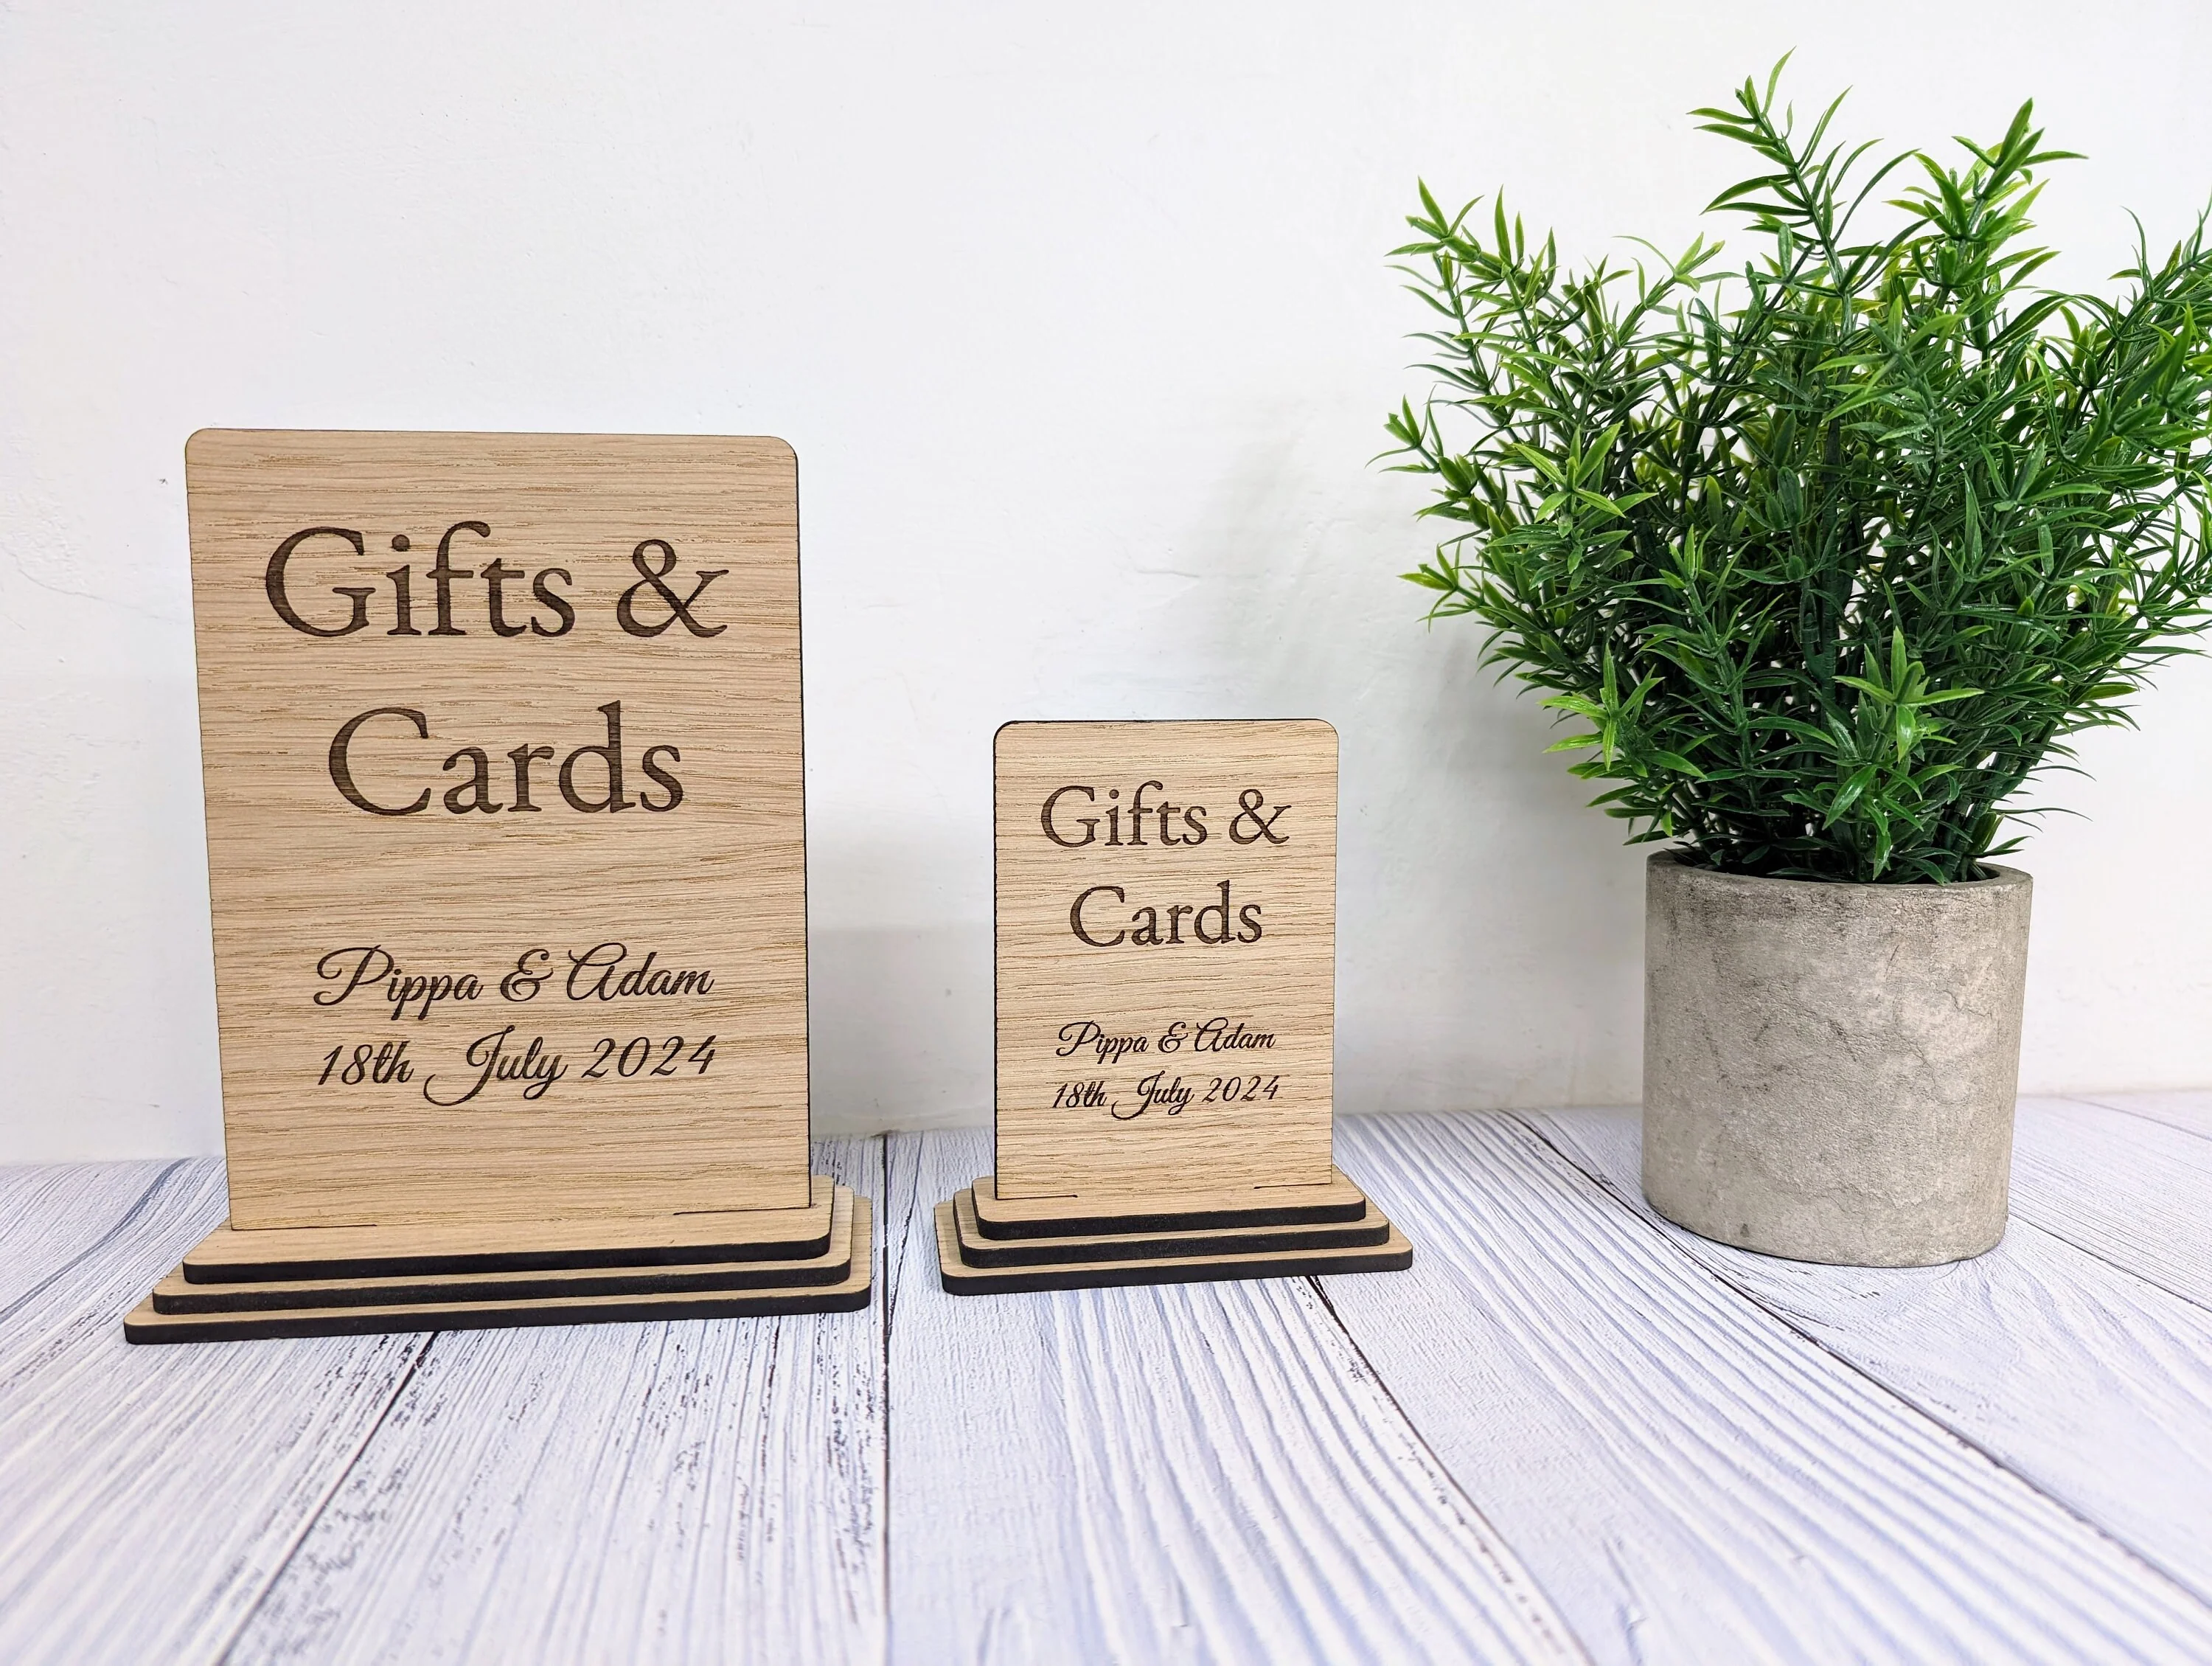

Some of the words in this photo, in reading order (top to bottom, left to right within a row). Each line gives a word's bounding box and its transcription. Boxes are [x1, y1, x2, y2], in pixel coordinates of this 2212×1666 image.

[265, 521, 577, 638] Gifts
[616, 539, 729, 639] &
[328, 700, 685, 816] Cards
[1040, 780, 1208, 847] Gifts
[1229, 788, 1292, 845] &
[1070, 880, 1265, 947] Cards
[314, 945, 484, 1021] Pippa
[499, 949, 554, 1002] &
[565, 942, 714, 1001] Adam
[316, 1040, 414, 1086] 18th
[423, 1025, 570, 1106] July
[581, 1035, 716, 1077] 2024
[1056, 1021, 1149, 1064] Pippa
[1158, 1021, 1190, 1053] &
[1193, 1017, 1276, 1052] Adam
[1051, 1080, 1107, 1108] 18th
[1111, 1070, 1194, 1120] July
[1202, 1075, 1280, 1103] 2024
